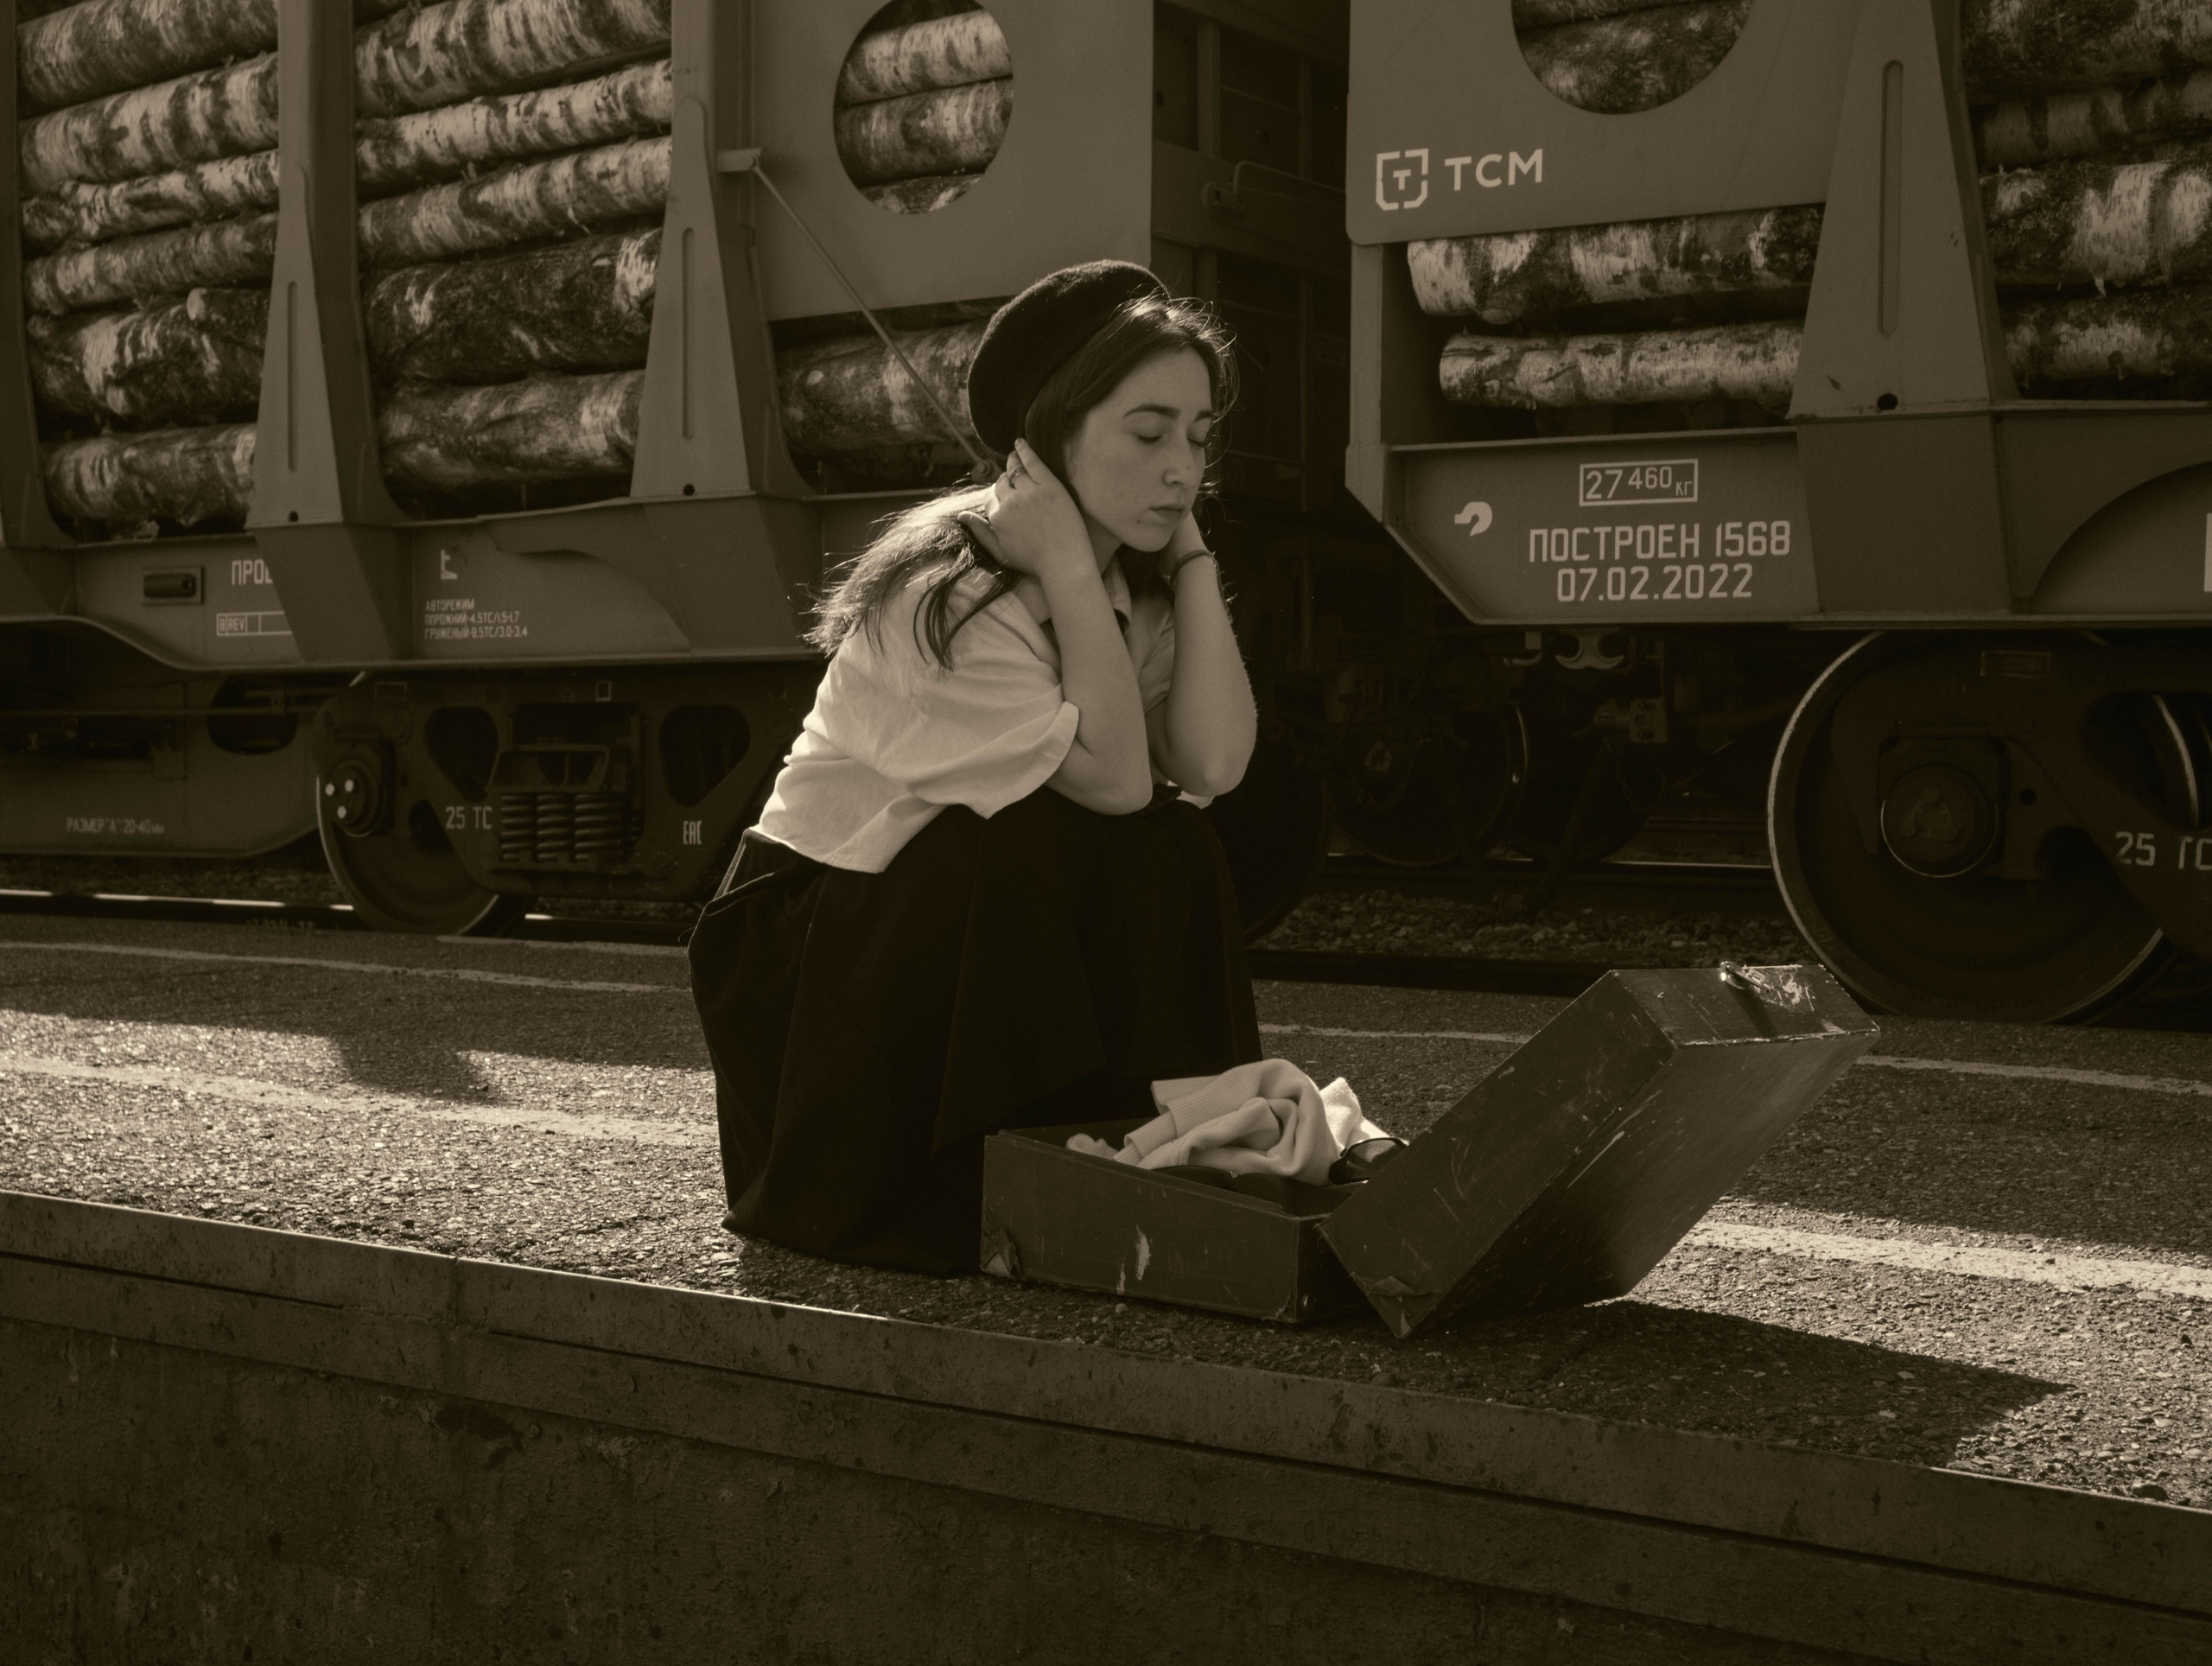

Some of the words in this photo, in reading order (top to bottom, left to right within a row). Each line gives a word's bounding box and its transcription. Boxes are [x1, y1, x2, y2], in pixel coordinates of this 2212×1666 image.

[1444, 148, 1543, 191] ТСМ
[1529, 523, 1700, 563] ПОСТРОЕН
[1715, 520, 1791, 557] 1568
[1556, 563, 1753, 602] 07.02.2022
[424, 598, 474, 611] АВТОРЕЖИМ
[445, 805, 466, 830] 25
[473, 805, 493, 830] ТС
[2114, 830, 2156, 867] 25
